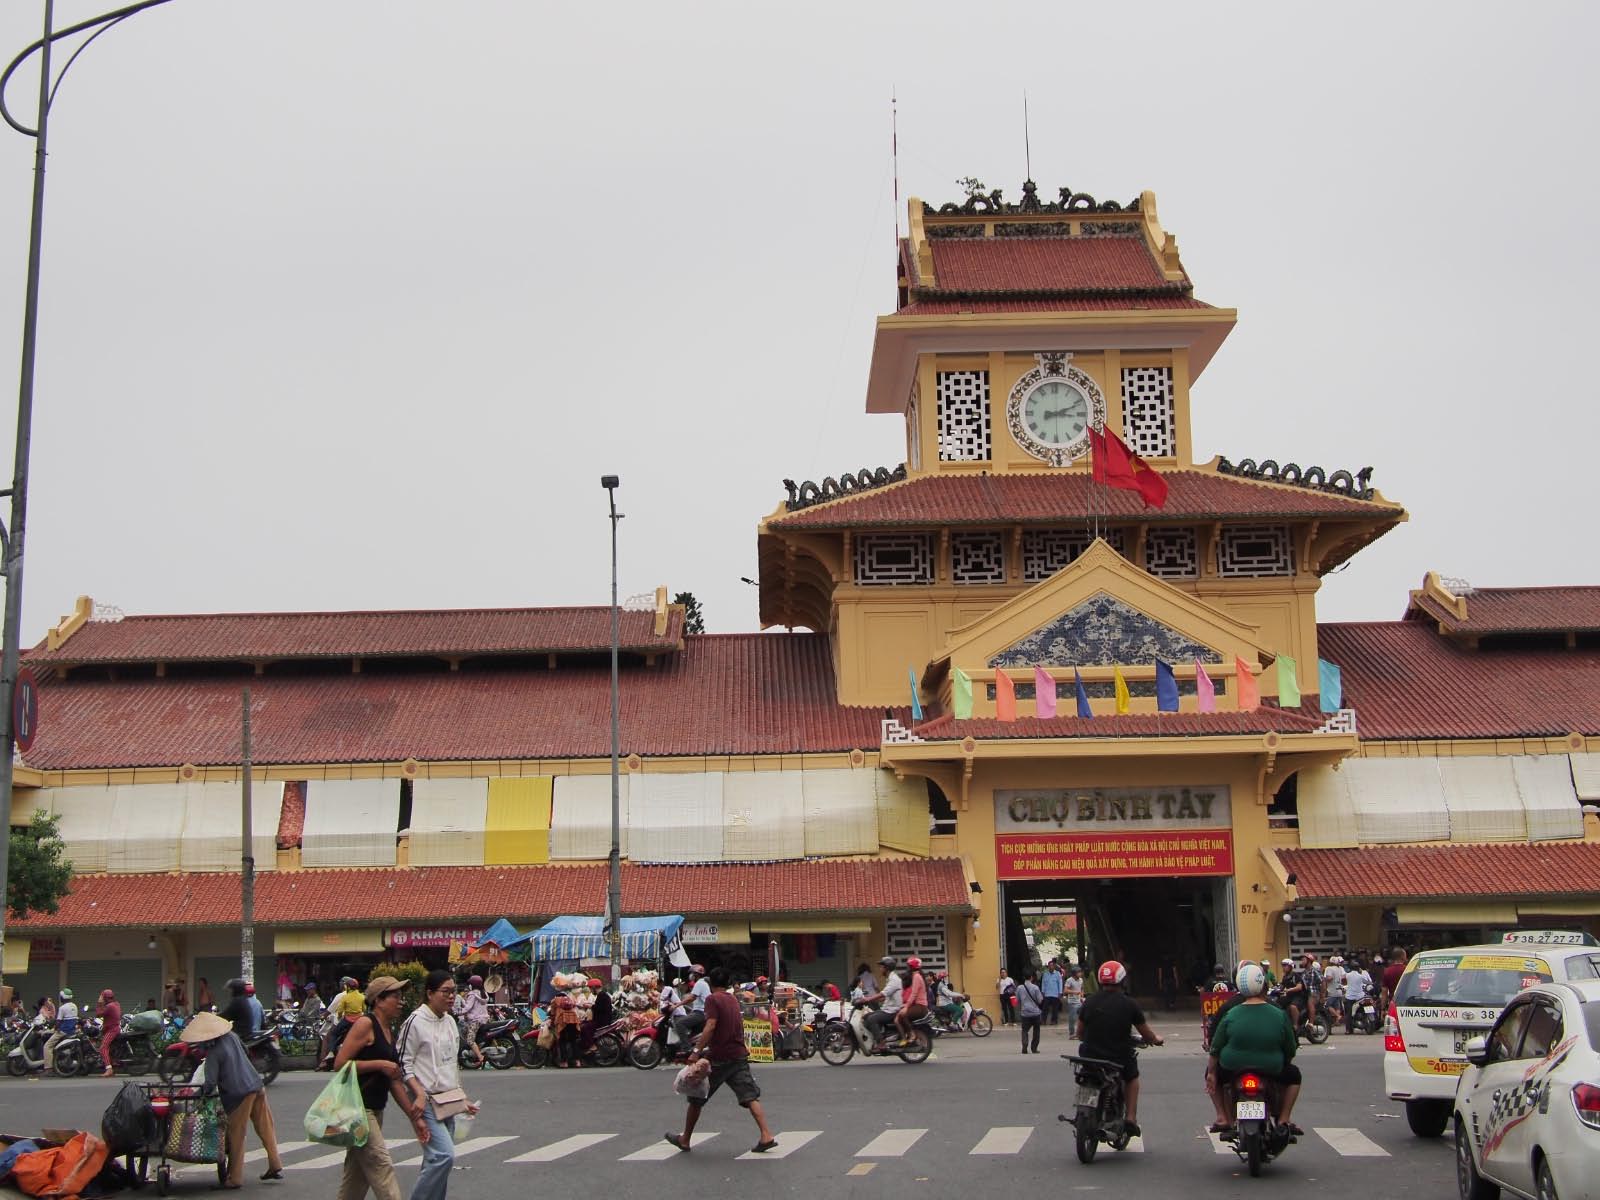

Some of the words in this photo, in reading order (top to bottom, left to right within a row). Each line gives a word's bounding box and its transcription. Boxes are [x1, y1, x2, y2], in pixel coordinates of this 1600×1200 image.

[1008, 792, 1069, 828] CHỢ
[1076, 791, 1152, 821] BÌNH
[1157, 788, 1216, 819] TÂY
[1241, 904, 1258, 914] 57A
